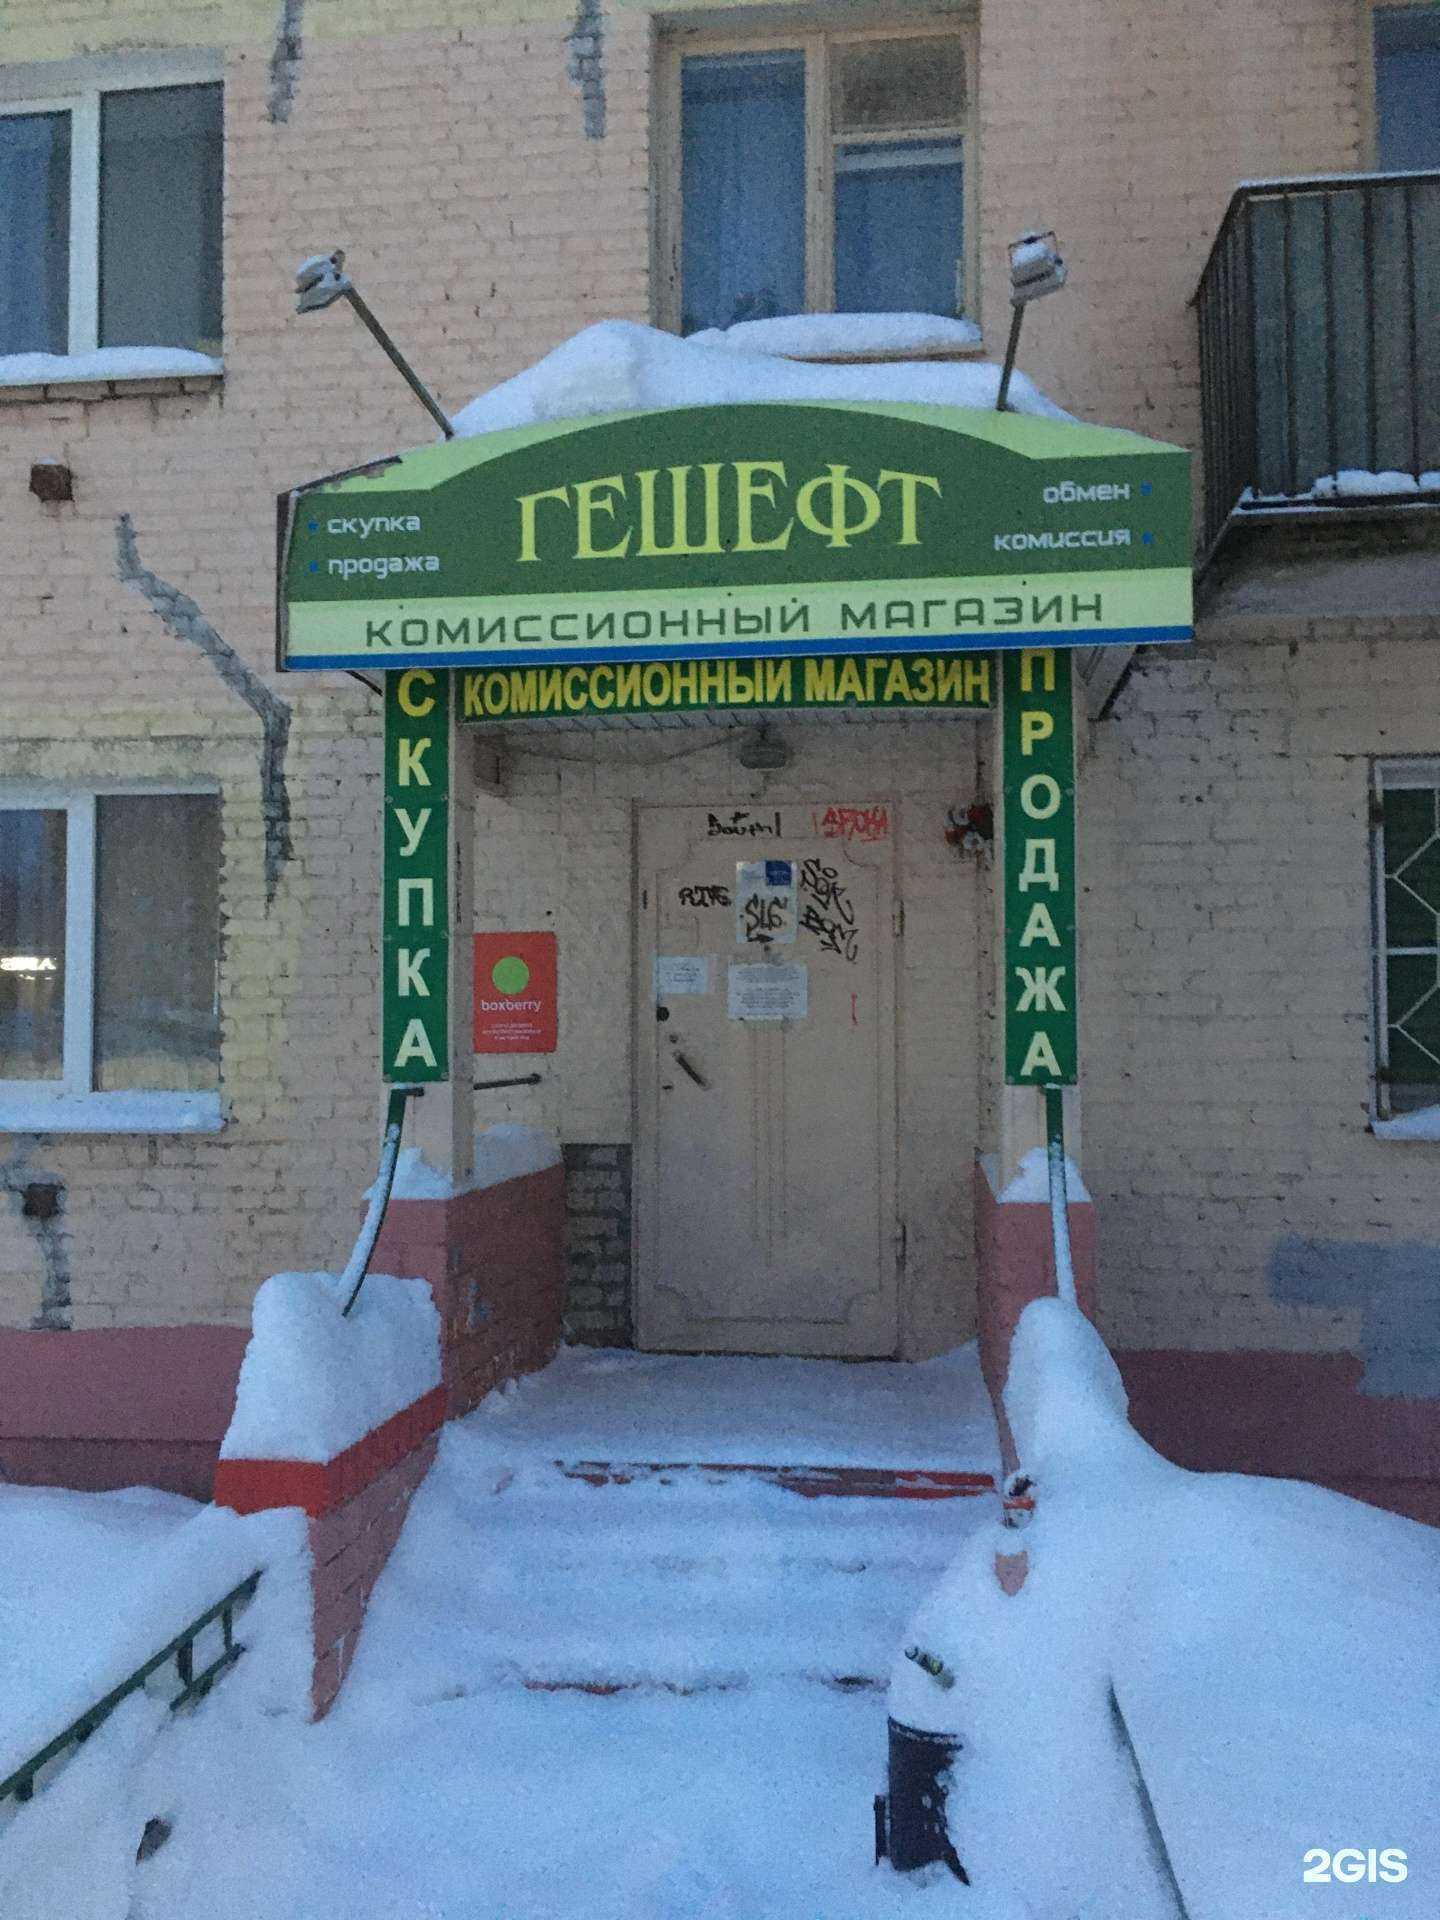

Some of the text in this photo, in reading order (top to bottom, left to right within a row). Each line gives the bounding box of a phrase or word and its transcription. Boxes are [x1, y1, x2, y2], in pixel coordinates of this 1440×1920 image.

[1042, 480, 1131, 504] обмен
[326, 513, 422, 537] скупка
[515, 460, 943, 562] ГЕШЕФТ
[993, 527, 1131, 551] комиссия
[326, 552, 441, 580] продажа
[365, 593, 1102, 648] КОМИССИОННЫЙ МАГАЗИН
[804, 658, 991, 703] МАГАЗИН
[394, 669, 438, 1068] СКУПКА
[1015, 648, 1067, 1077] ПРОДАЖА
[481, 999, 542, 1012] boxberry
